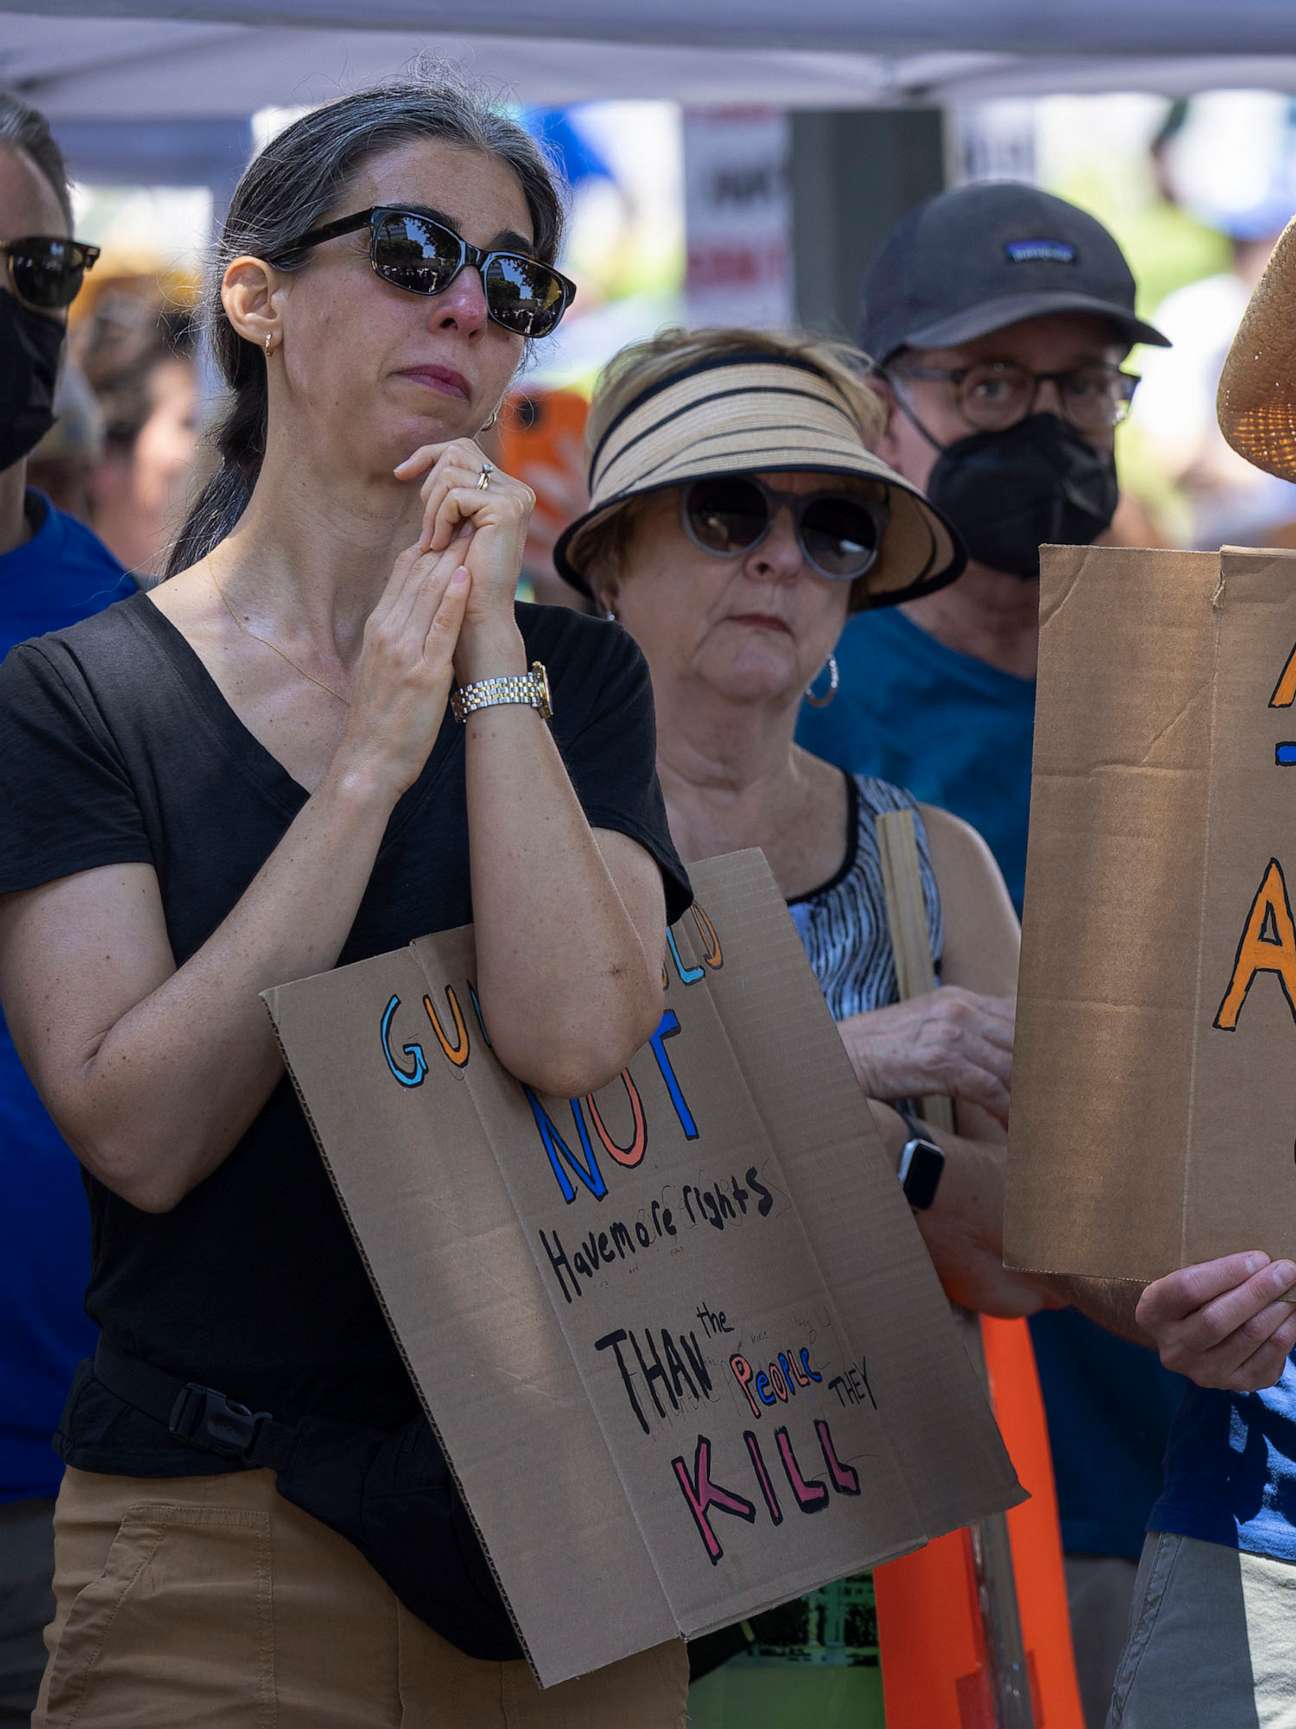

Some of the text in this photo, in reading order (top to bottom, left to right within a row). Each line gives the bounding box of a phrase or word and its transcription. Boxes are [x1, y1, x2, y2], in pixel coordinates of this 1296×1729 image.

[520, 1008, 700, 1205] NOT
[595, 1328, 712, 1435] THAN
[828, 1356, 878, 1410] THEY
[696, 1302, 735, 1338] the
[671, 1419, 861, 1566] KILL
